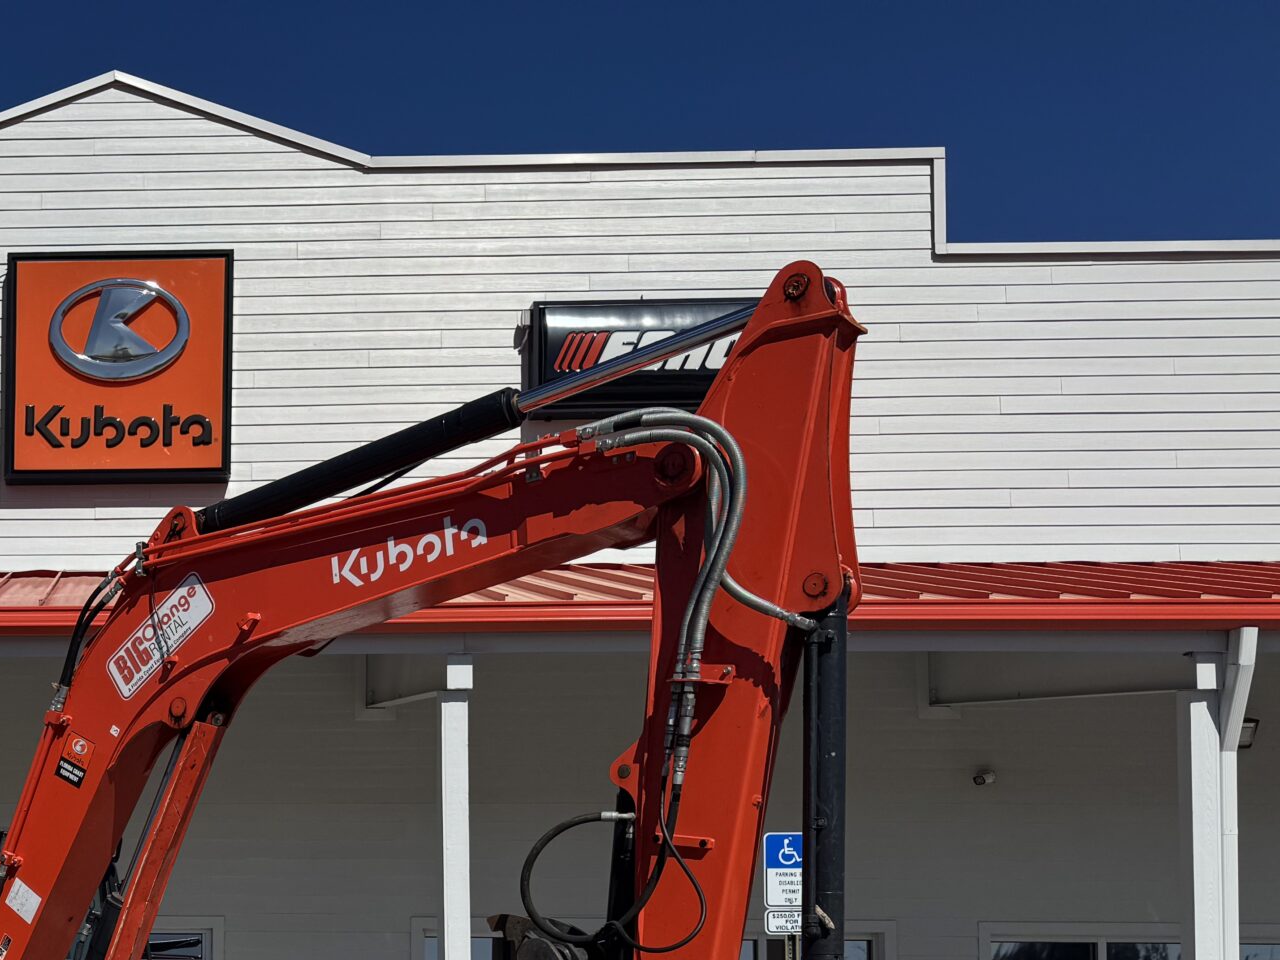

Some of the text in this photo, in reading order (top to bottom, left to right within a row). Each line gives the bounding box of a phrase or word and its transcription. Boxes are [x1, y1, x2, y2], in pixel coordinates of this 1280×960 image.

[25, 404, 213, 449] Kubota
[331, 516, 488, 588] Kubota
[113, 585, 197, 687] BIG Orange
[148, 615, 189, 657] RENTAL
[173, 626, 192, 646] Company
